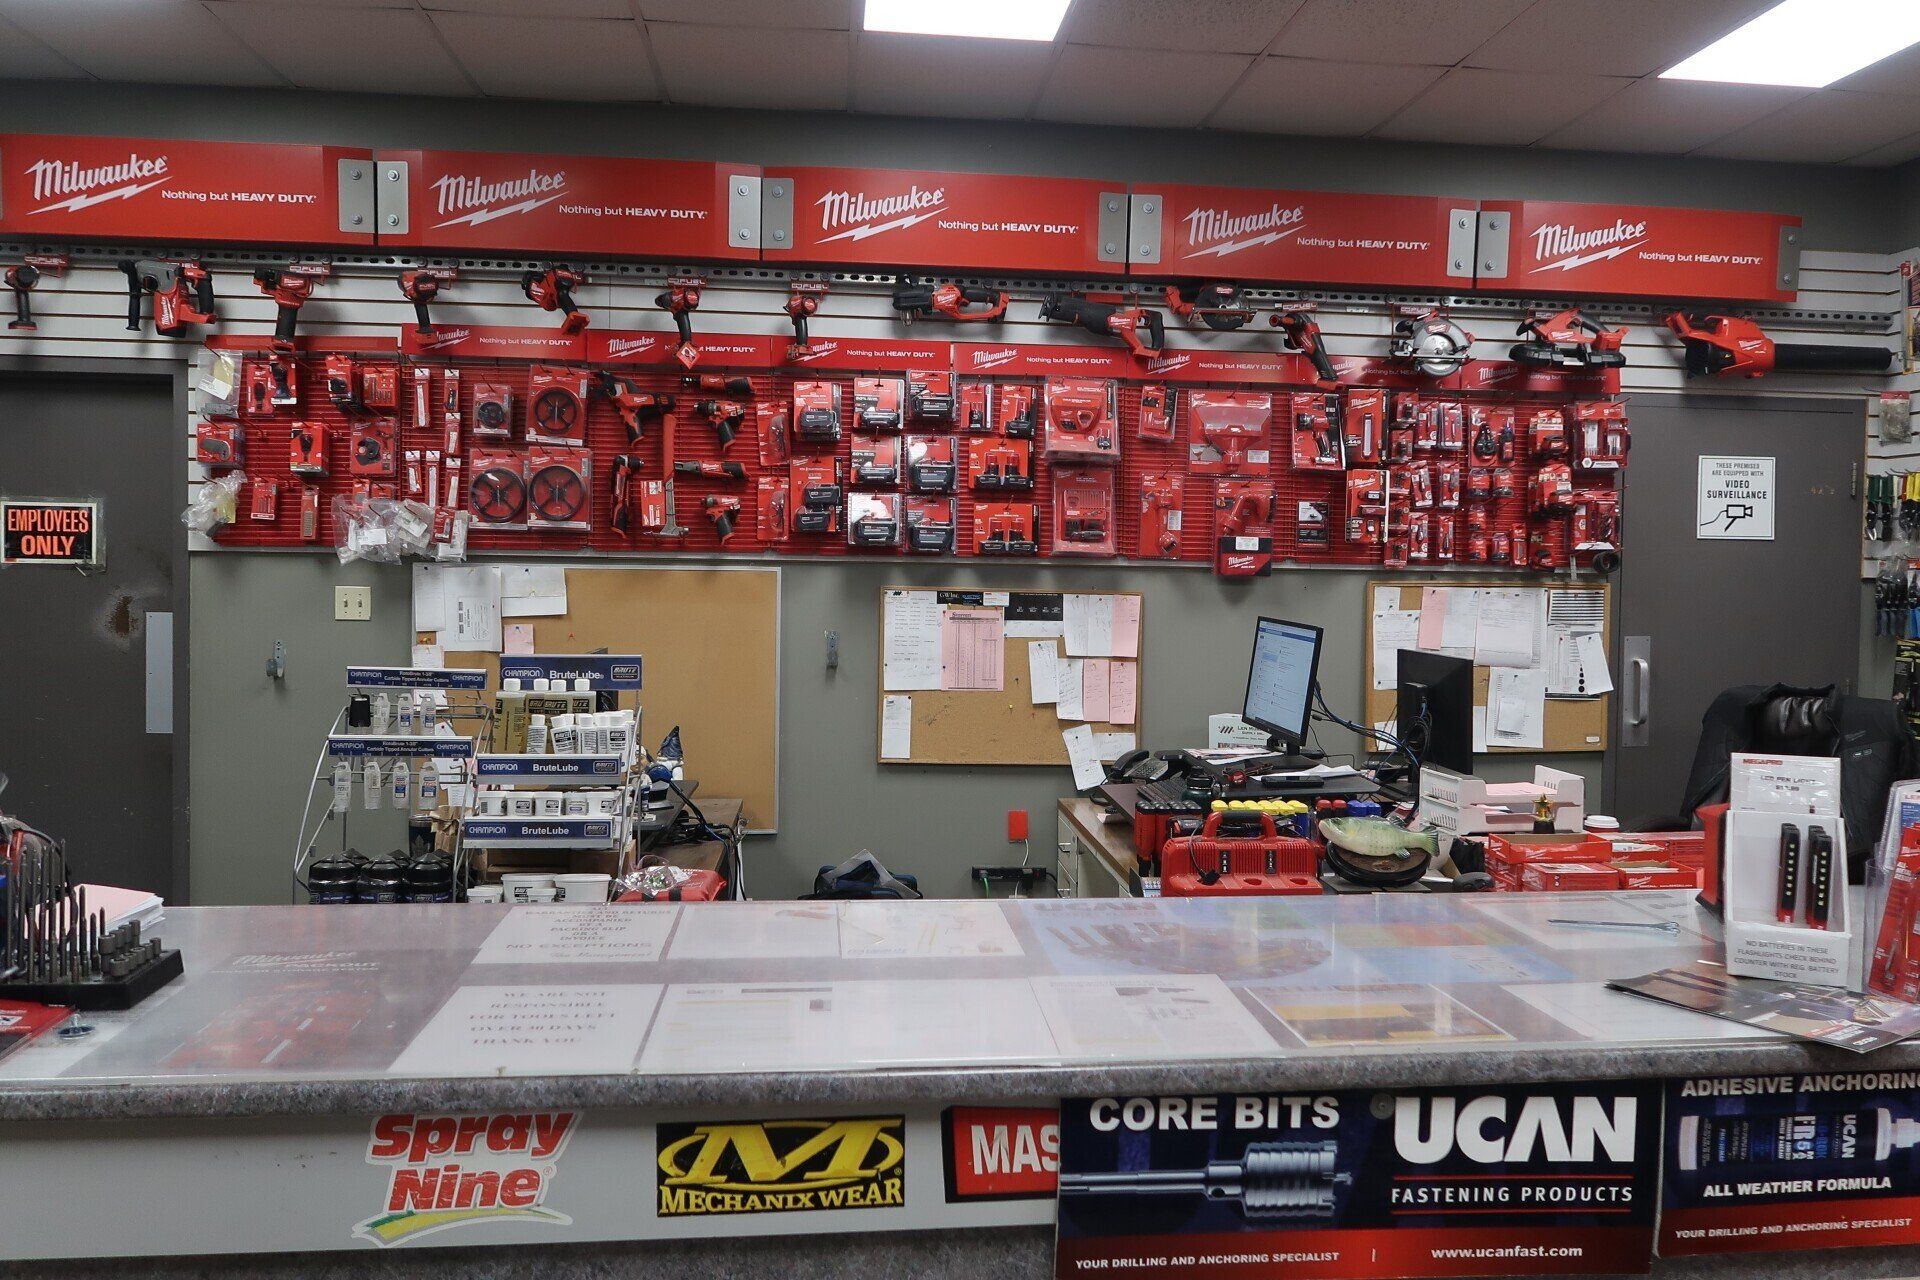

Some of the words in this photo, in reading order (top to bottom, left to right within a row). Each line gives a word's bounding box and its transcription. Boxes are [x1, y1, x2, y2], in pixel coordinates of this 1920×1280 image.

[24, 154, 168, 200] Milwaukee
[162, 190, 206, 202] Nothing
[210, 191, 229, 201] but
[231, 192, 274, 202] HEAVY
[429, 169, 565, 215] Milwaukee
[559, 204, 601, 216] Nothing
[604, 206, 622, 215] but
[625, 207, 667, 217] HEAVY
[814, 186, 944, 231] Milwaukee
[938, 220, 979, 232] Nothing
[981, 222, 999, 231] but
[1001, 222, 1041, 232] HEAVY
[1182, 204, 1303, 246] Milwaukee
[1297, 237, 1335, 248] Nothing
[1338, 239, 1354, 247] but
[1356, 239, 1393, 249] HEAVY
[1529, 218, 1647, 261] Milwaukee
[1639, 251, 1675, 263] Nothing
[1677, 253, 1692, 262] but
[1695, 254, 1729, 264] HEAVY
[479, 337, 504, 347] Nothing
[521, 338, 547, 346] HEAVY
[608, 336, 655, 353] Milwaukee
[847, 350, 873, 358] Nothing
[887, 350, 912, 358] HEAVY
[972, 348, 1017, 365] Milwaukee
[1026, 356, 1048, 364] Nothing
[1199, 362, 1223, 370] Nothing
[1725, 480, 1750, 488] VIDEO
[1707, 490, 1767, 499] SURVEILLANCE
[8, 509, 89, 533] EMPLOYEES
[21, 535, 75, 556] ONLY
[549, 670, 600, 680] BruteLube
[532, 764, 579, 772] BruteLube
[521, 827, 569, 835] BruteLube
[1759, 940, 1795, 950] BATTERIES
[1807, 946, 1828, 955] THESE
[1734, 957, 1767, 966] COUNTER
[1808, 965, 1839, 974] BATTERY
[1737, 949, 1782, 959] FLASHLIGHTS
[1785, 954, 1807, 962] CHECK
[1810, 956, 1836, 965] BEHIND
[1774, 970, 1797, 979] STOCK
[1681, 1077, 1794, 1097] ADHESIVE
[1089, 1097, 1219, 1132] CORE
[1235, 1096, 1340, 1130] BITS
[373, 1111, 573, 1156] Spray
[1394, 1096, 1637, 1164] UCAN
[1841, 1114, 1857, 1159] UCAN
[391, 1166, 540, 1212] Nine
[659, 1183, 815, 1216] MECHANIX
[820, 1176, 903, 1207] WEAR
[1392, 1187, 1511, 1203] FASTENING
[1521, 1185, 1633, 1202] PRODUCTS
[1703, 1184, 1735, 1198] ALL
[1737, 1181, 1815, 1196] WEATHER
[1817, 1177, 1892, 1193] FORMULA
[1675, 1230, 1706, 1240] YOUR
[1708, 1226, 1758, 1238] DRILLING
[1760, 1225, 1784, 1235] AND
[1786, 1221, 1849, 1235] ANCHORING
[1850, 1217, 1911, 1230] SPECIALIST
[1076, 1258, 1111, 1269] YOUR
[1112, 1256, 1167, 1268] DRILLING
[1169, 1255, 1196, 1265] AND
[1199, 1253, 1270, 1265] ANCHORING
[1272, 1251, 1339, 1263] SPECIALIST
[1431, 1244, 1583, 1259] www.ucanfast.com
